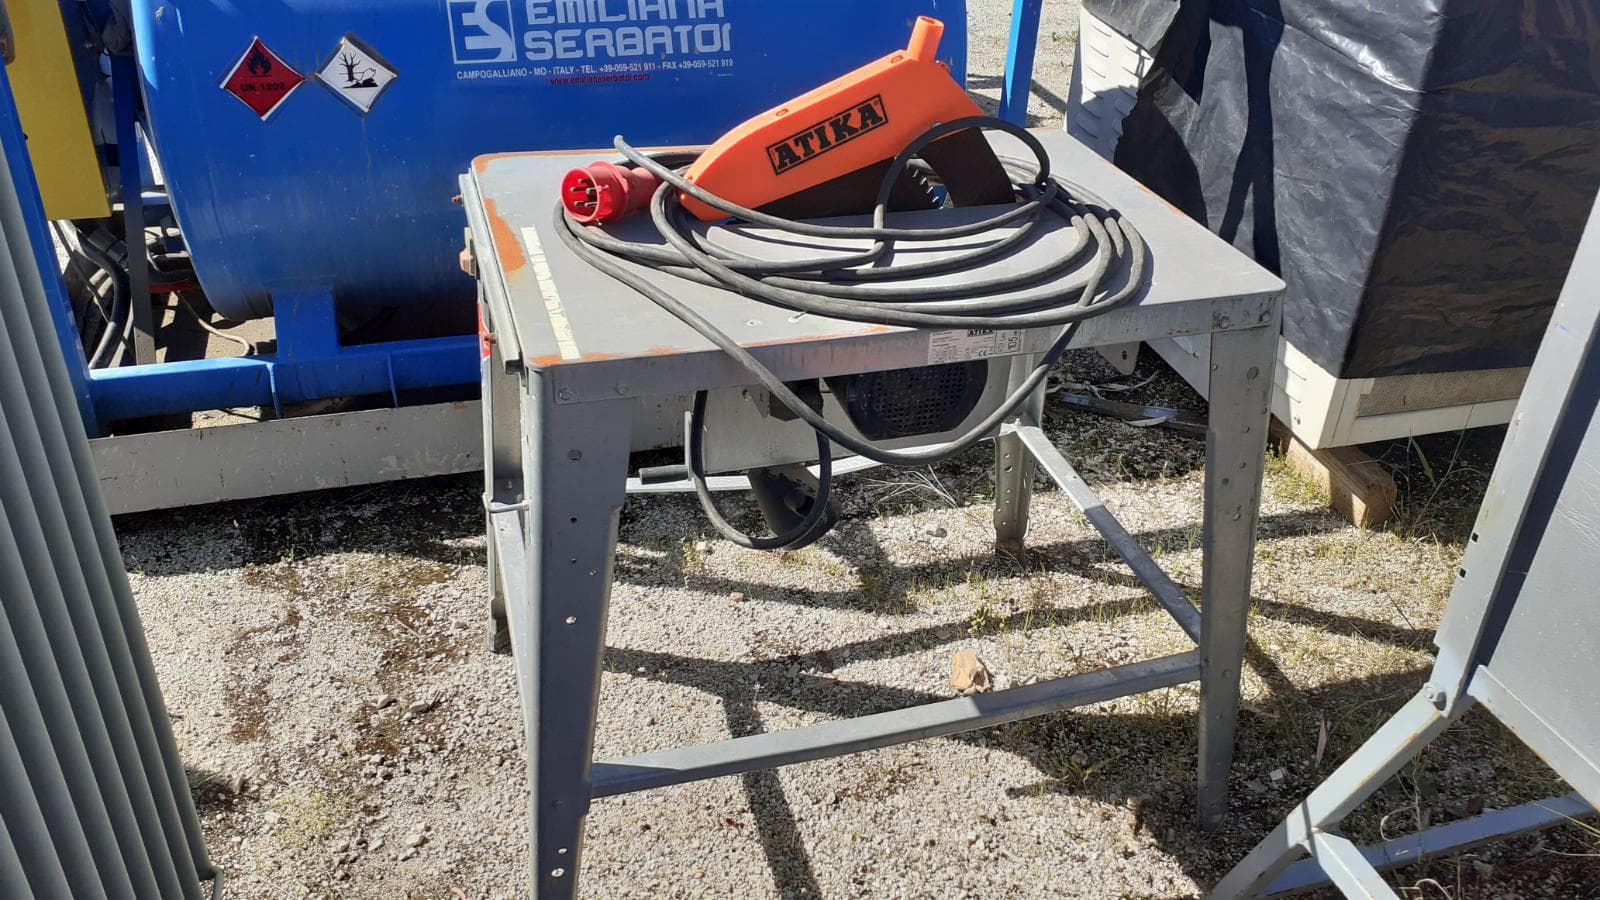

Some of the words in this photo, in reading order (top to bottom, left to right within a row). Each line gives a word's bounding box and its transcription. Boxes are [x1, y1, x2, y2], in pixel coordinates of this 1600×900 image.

[525, 0, 725, 25] EMILIANA
[523, 22, 732, 61] SERBATOI
[456, 67, 528, 80] CAMPOGALLIANO
[533, 66, 547, 76] MO
[553, 65, 575, 75] ITALY
[581, 64, 598, 74] TEL.
[599, 62, 642, 73] +39-059-521
[643, 62, 656, 71] 911
[662, 60, 678, 70] FAX
[678, 59, 719, 69] +39-059-521
[721, 58, 734, 67] 919
[240, 83, 256, 92] UN
[260, 82, 286, 91] 1202
[773, 102, 884, 171] ATIKA
